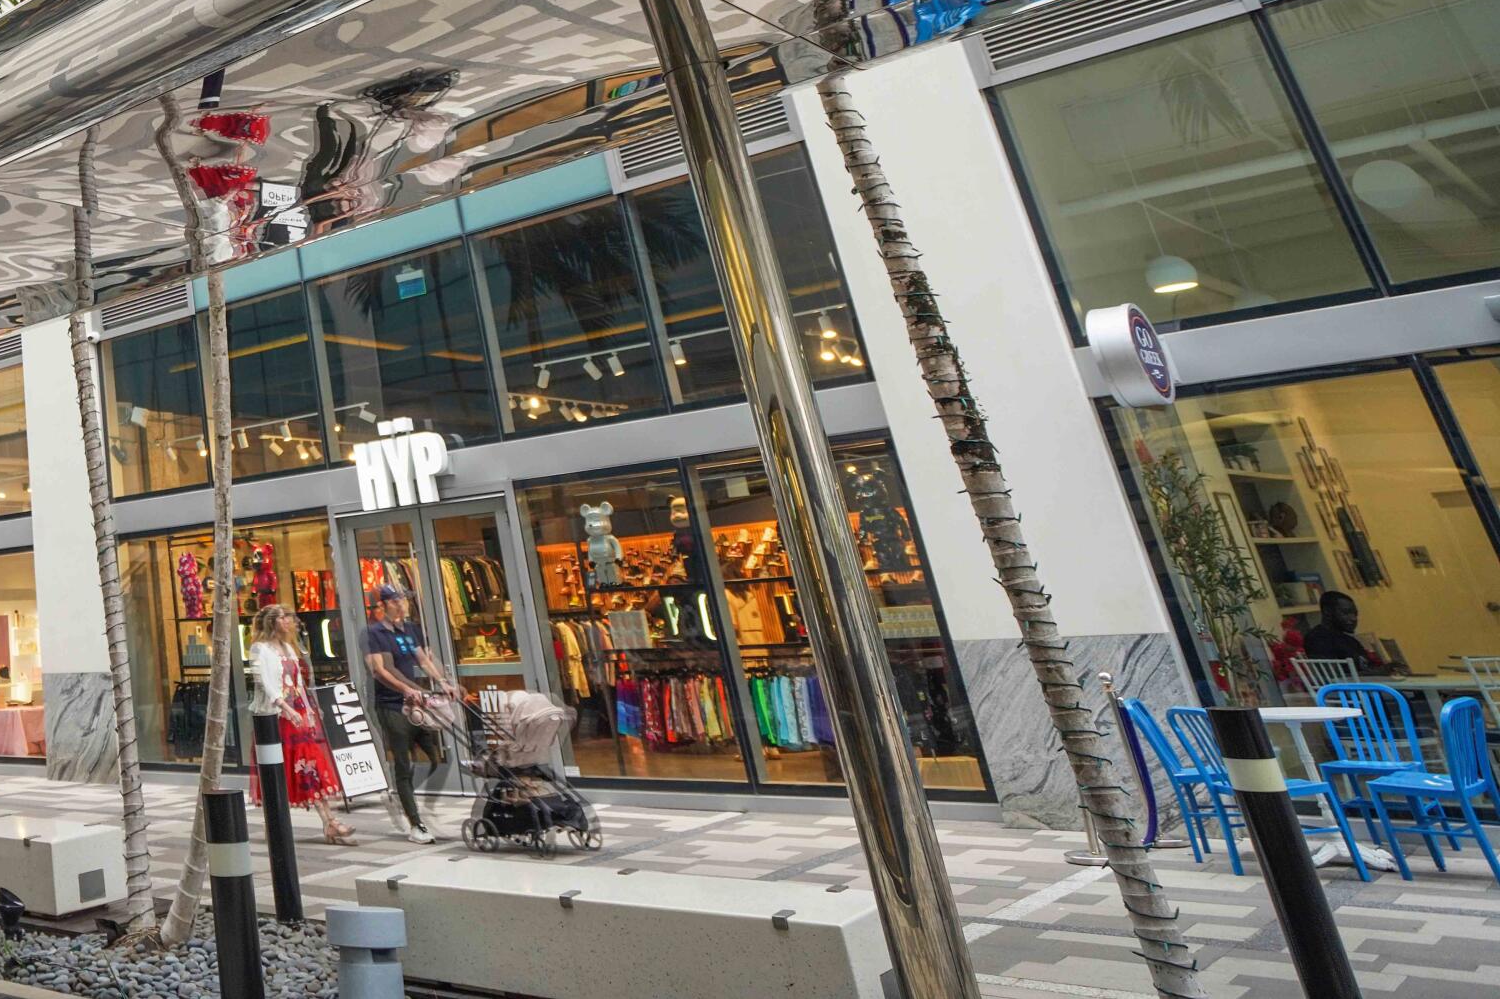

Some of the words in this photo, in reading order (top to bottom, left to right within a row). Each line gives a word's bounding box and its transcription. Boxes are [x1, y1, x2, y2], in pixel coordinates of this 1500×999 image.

[1135, 326, 1154, 349] GO
[335, 752, 353, 763] NOW
[345, 760, 373, 777] OPEN
